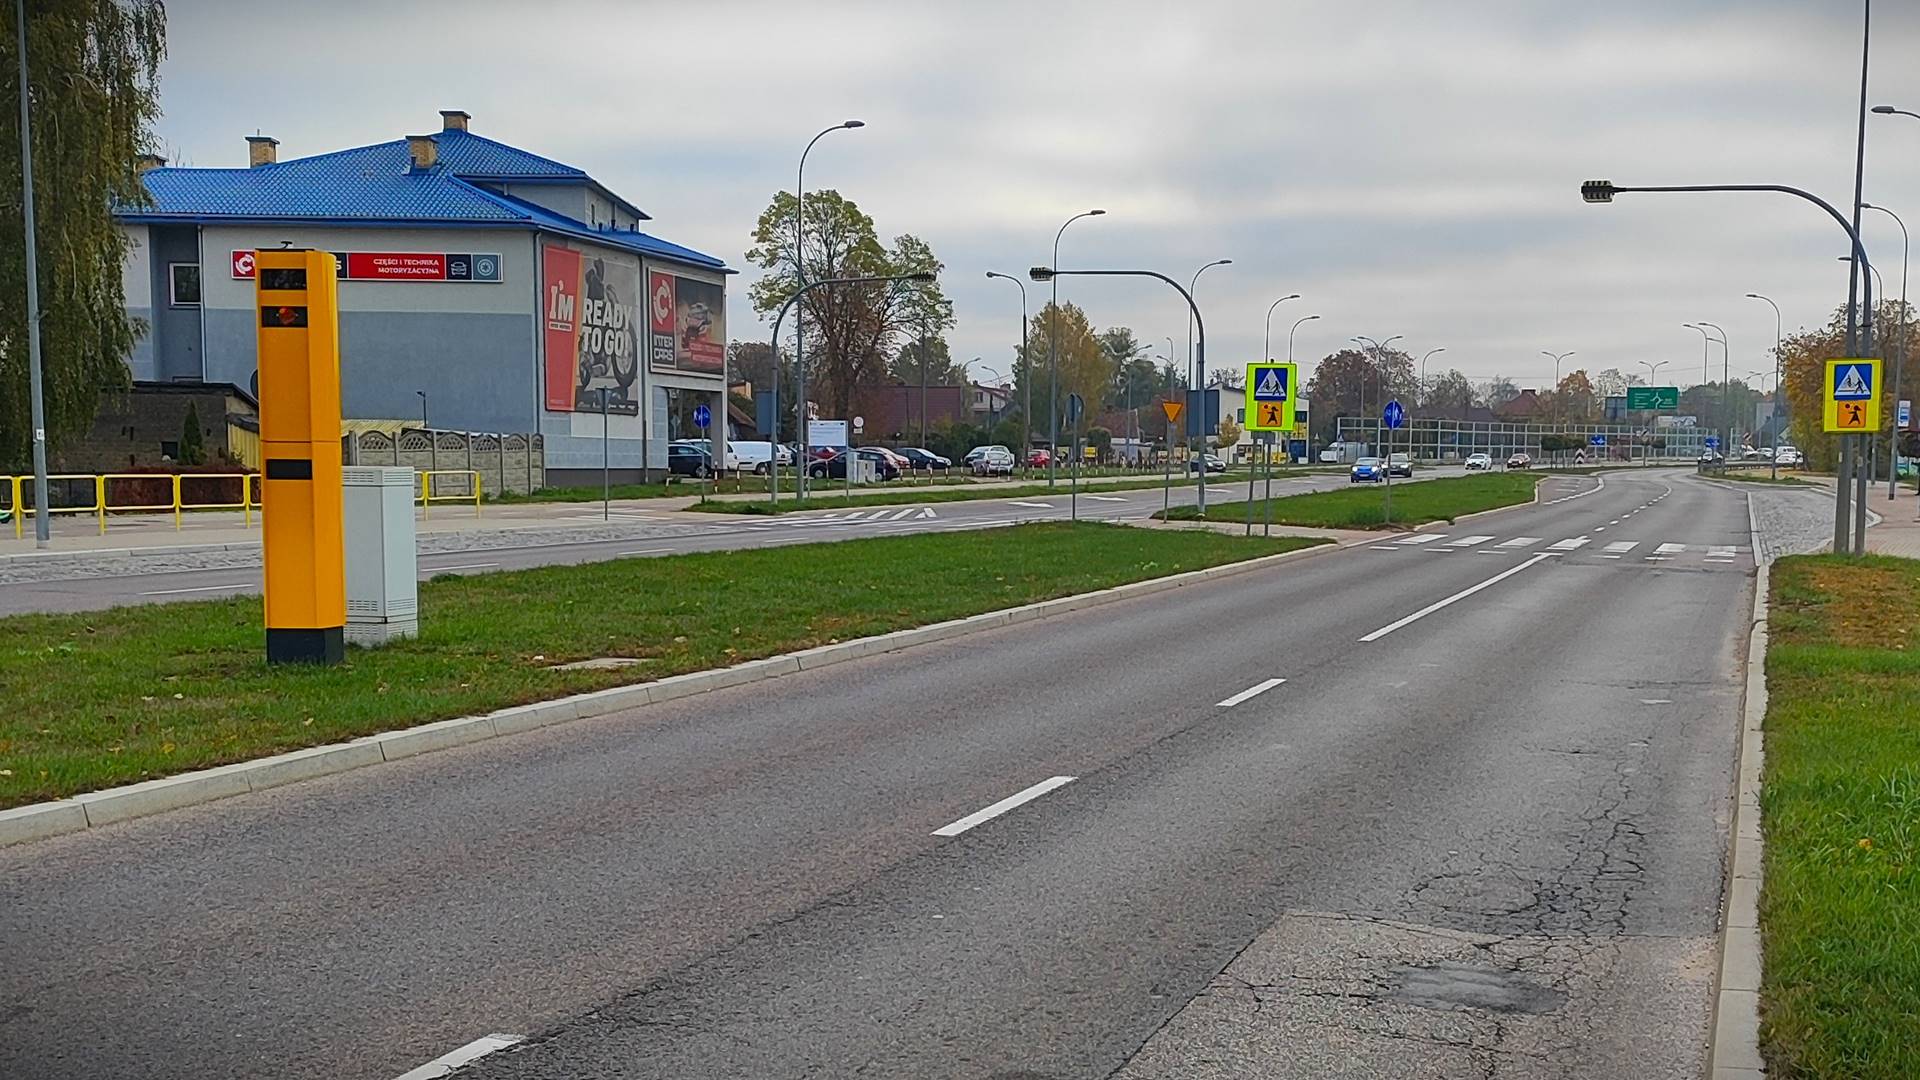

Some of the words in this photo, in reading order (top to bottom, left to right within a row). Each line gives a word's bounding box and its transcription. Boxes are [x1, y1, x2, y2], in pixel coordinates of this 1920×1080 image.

[373, 258, 398, 266] CZĘŚCI
[549, 279, 574, 322] I'M
[582, 297, 633, 330] READY
[582, 326, 602, 354] TO
[653, 334, 673, 347] INTER
[653, 348, 674, 361] CARS
